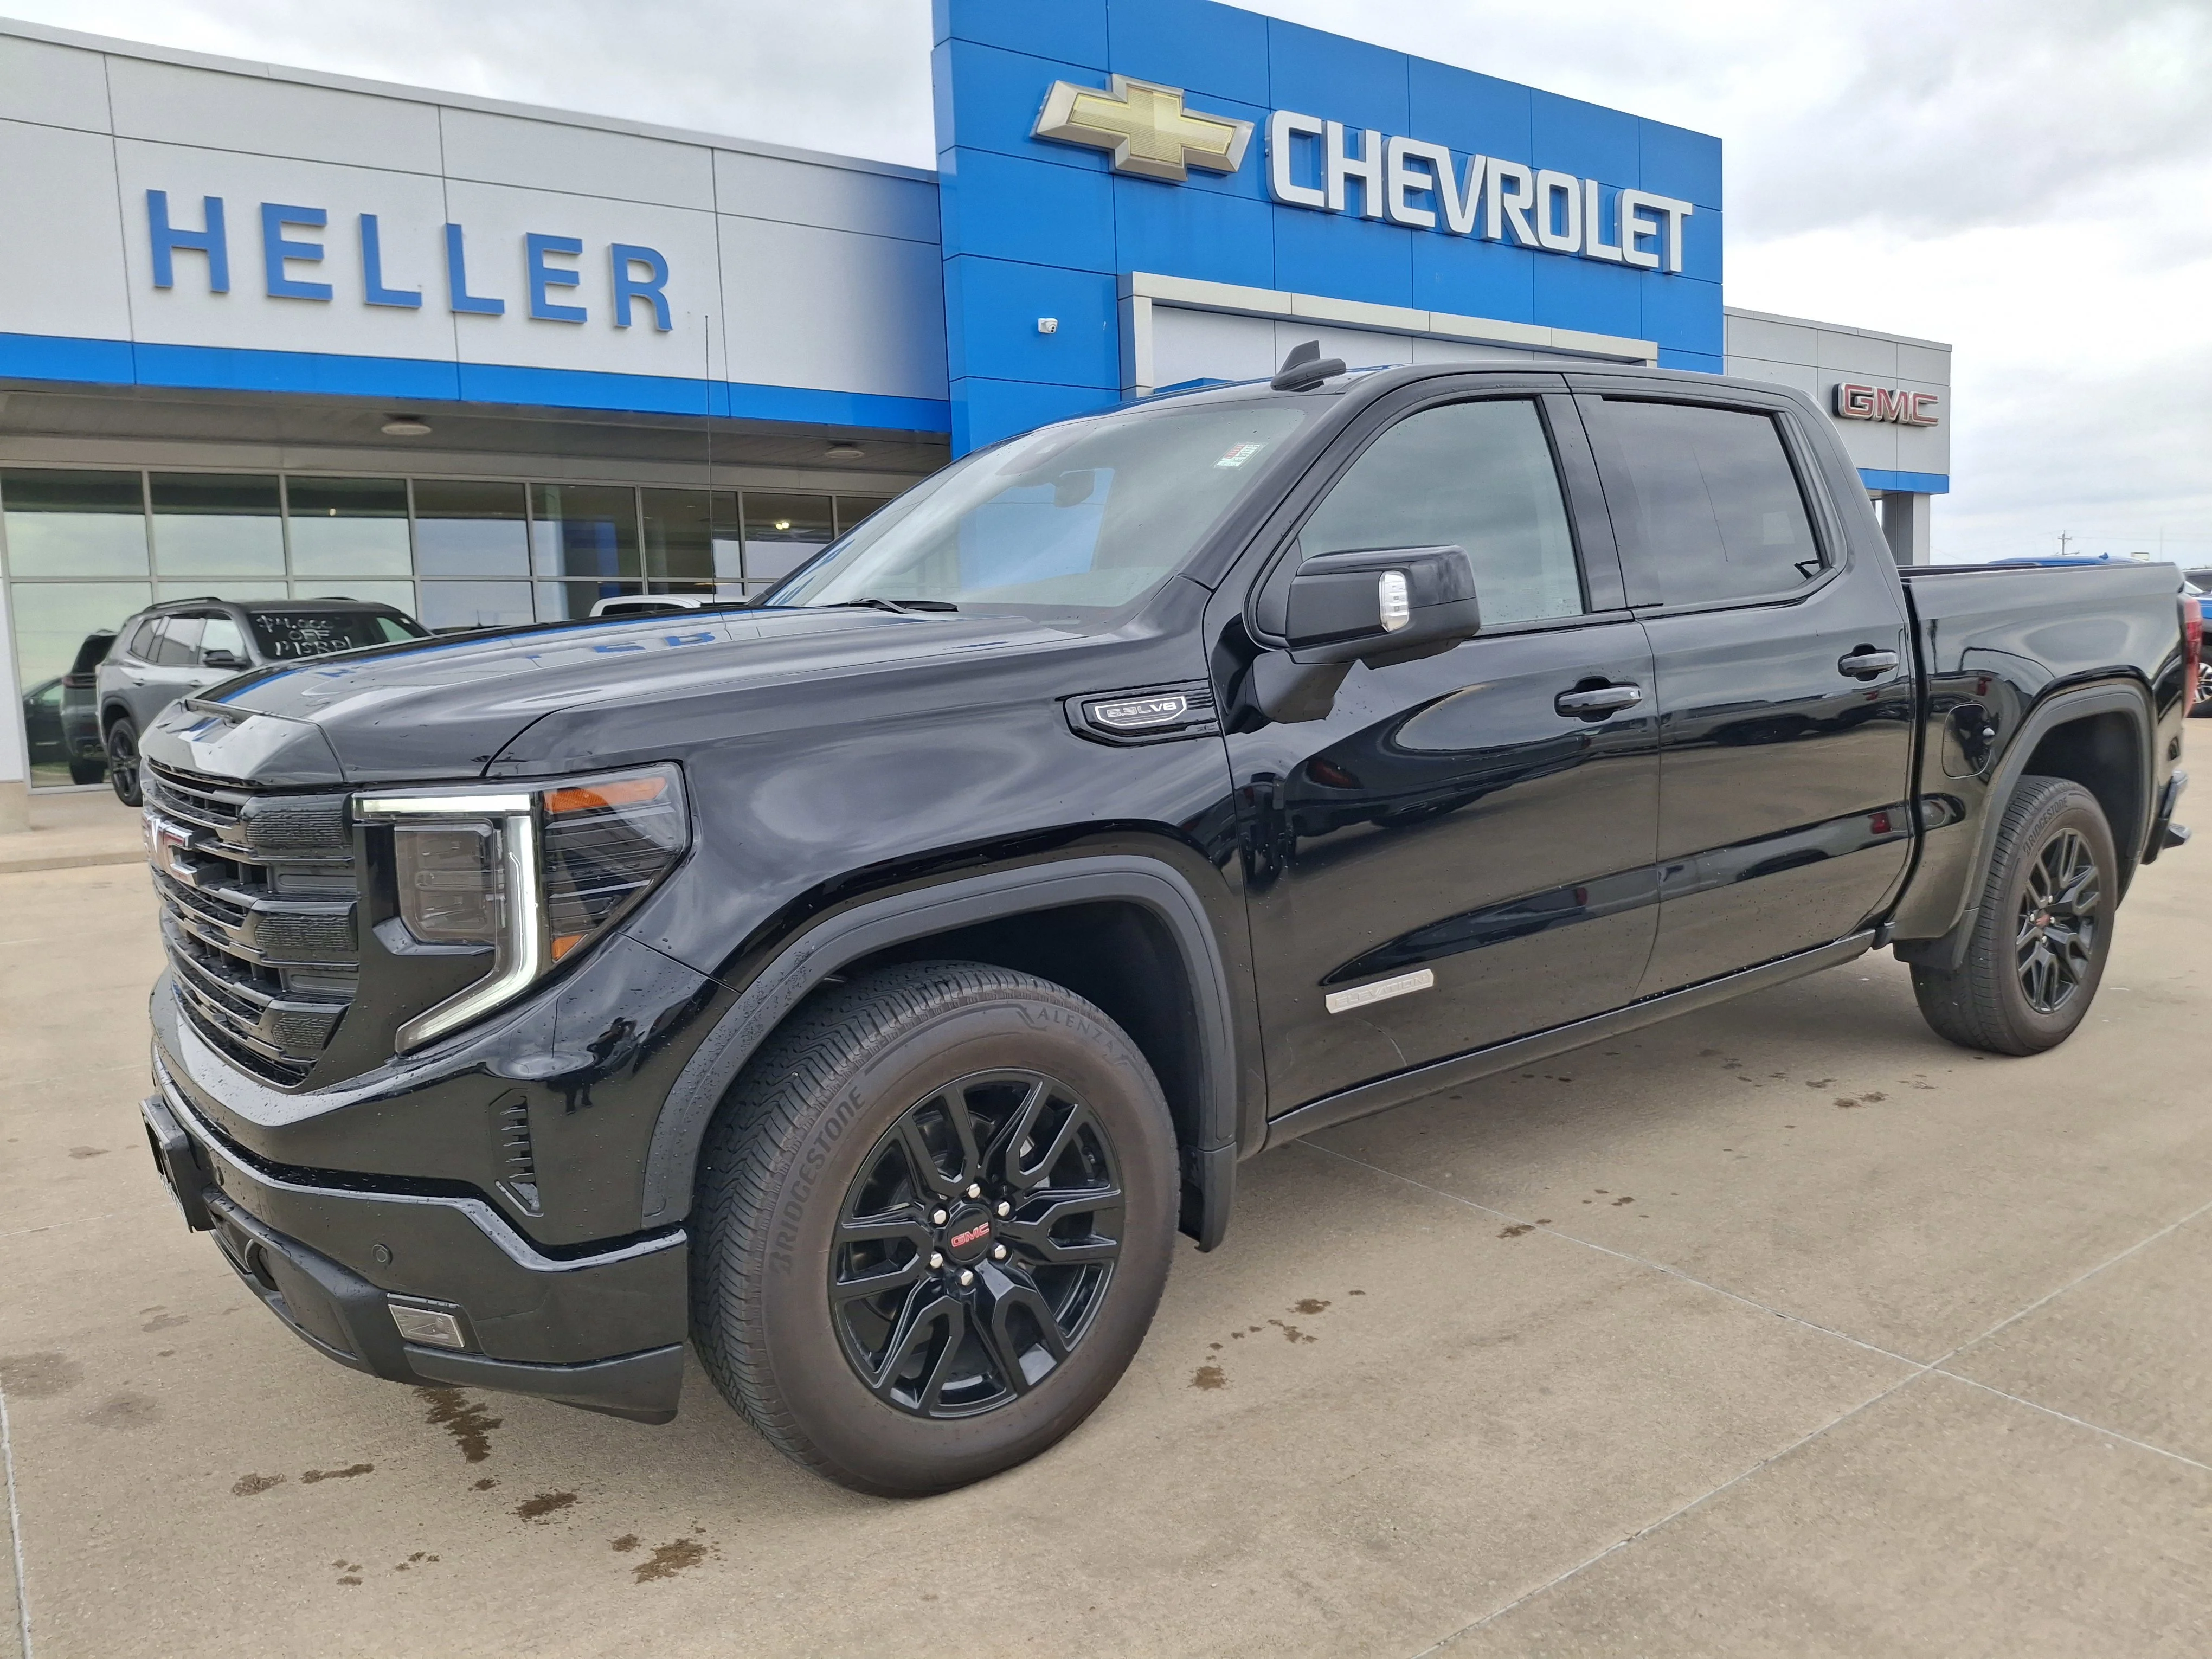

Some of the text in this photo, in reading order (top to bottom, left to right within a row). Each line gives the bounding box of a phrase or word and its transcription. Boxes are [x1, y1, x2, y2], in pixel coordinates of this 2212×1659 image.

[1265, 110, 1693, 274] CHEVROLET
[146, 189, 672, 331] HELLER
[1832, 382, 1939, 427] GMC
[289, 629, 330, 640] OFF
[1106, 702, 1176, 718] 5.3L V8
[1335, 975, 1426, 1007] ELEVATION
[1036, 1006, 1114, 1056] ALENZA
[769, 1086, 866, 1276] BRIDGESTONE
[951, 1221, 989, 1248] GMC
